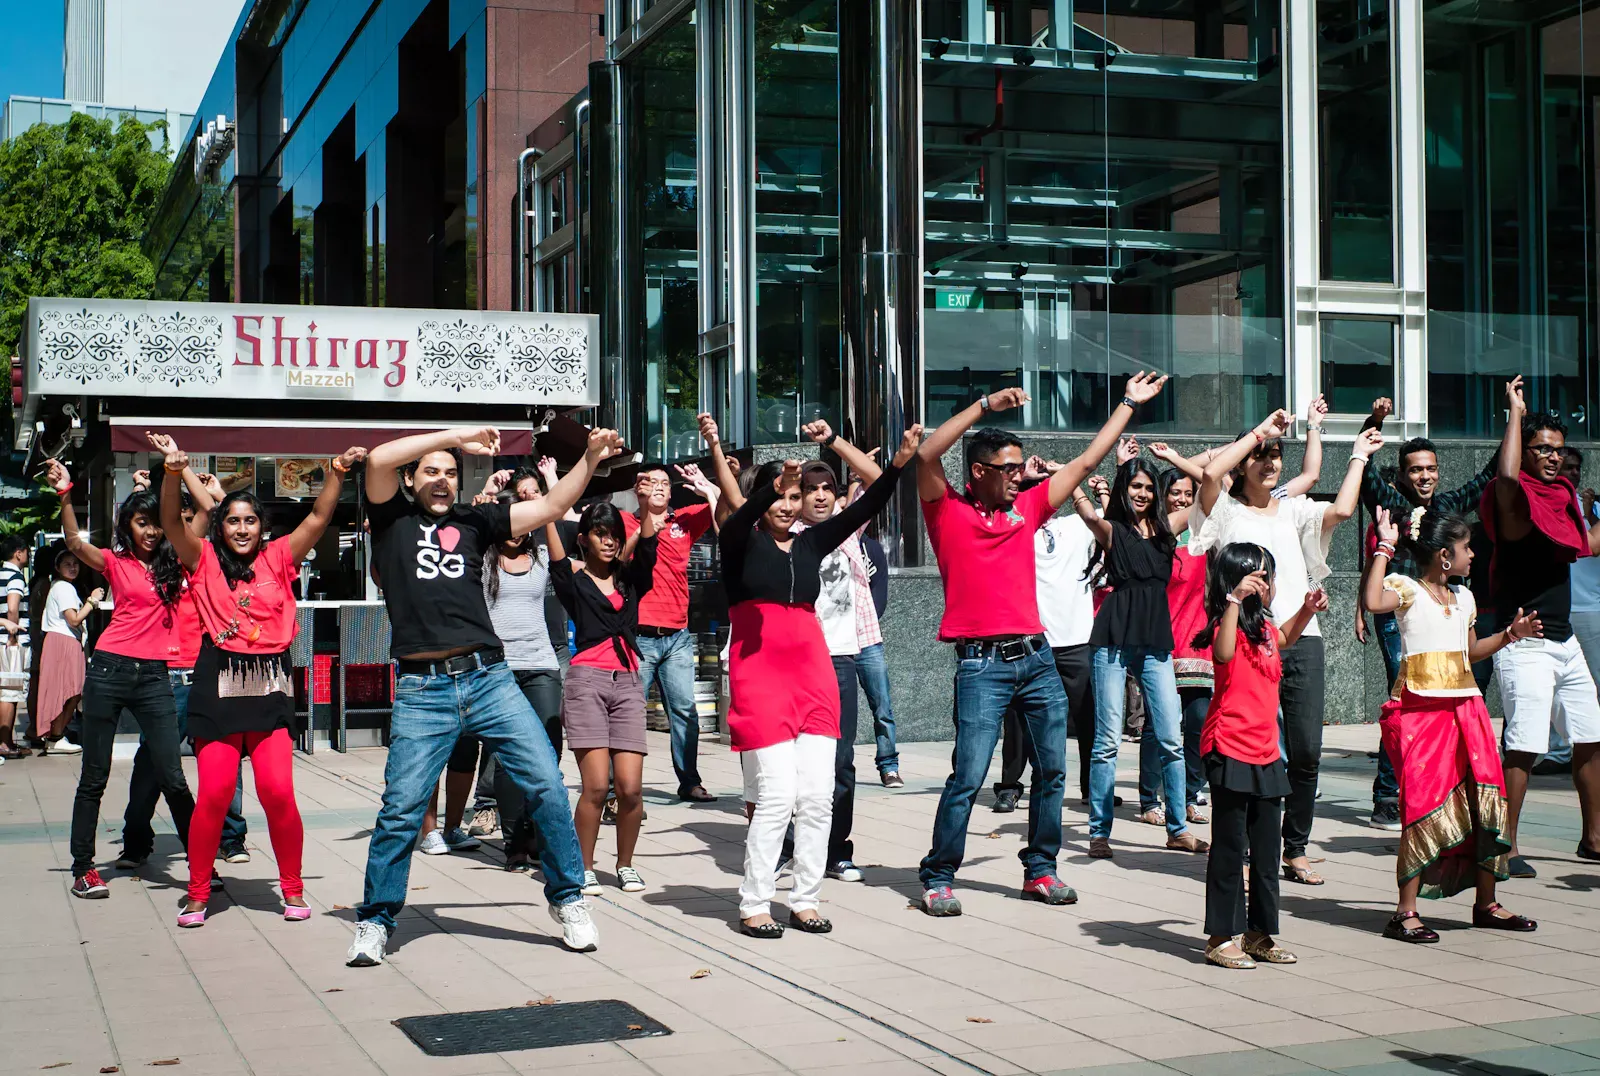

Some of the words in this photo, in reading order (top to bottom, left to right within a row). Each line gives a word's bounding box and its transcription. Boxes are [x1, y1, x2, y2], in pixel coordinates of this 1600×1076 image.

[948, 293, 972, 307] EXIT
[232, 315, 410, 388] Shiraz
[288, 370, 355, 387] Mazzeh
[416, 523, 440, 549] I
[416, 548, 465, 580] SG
